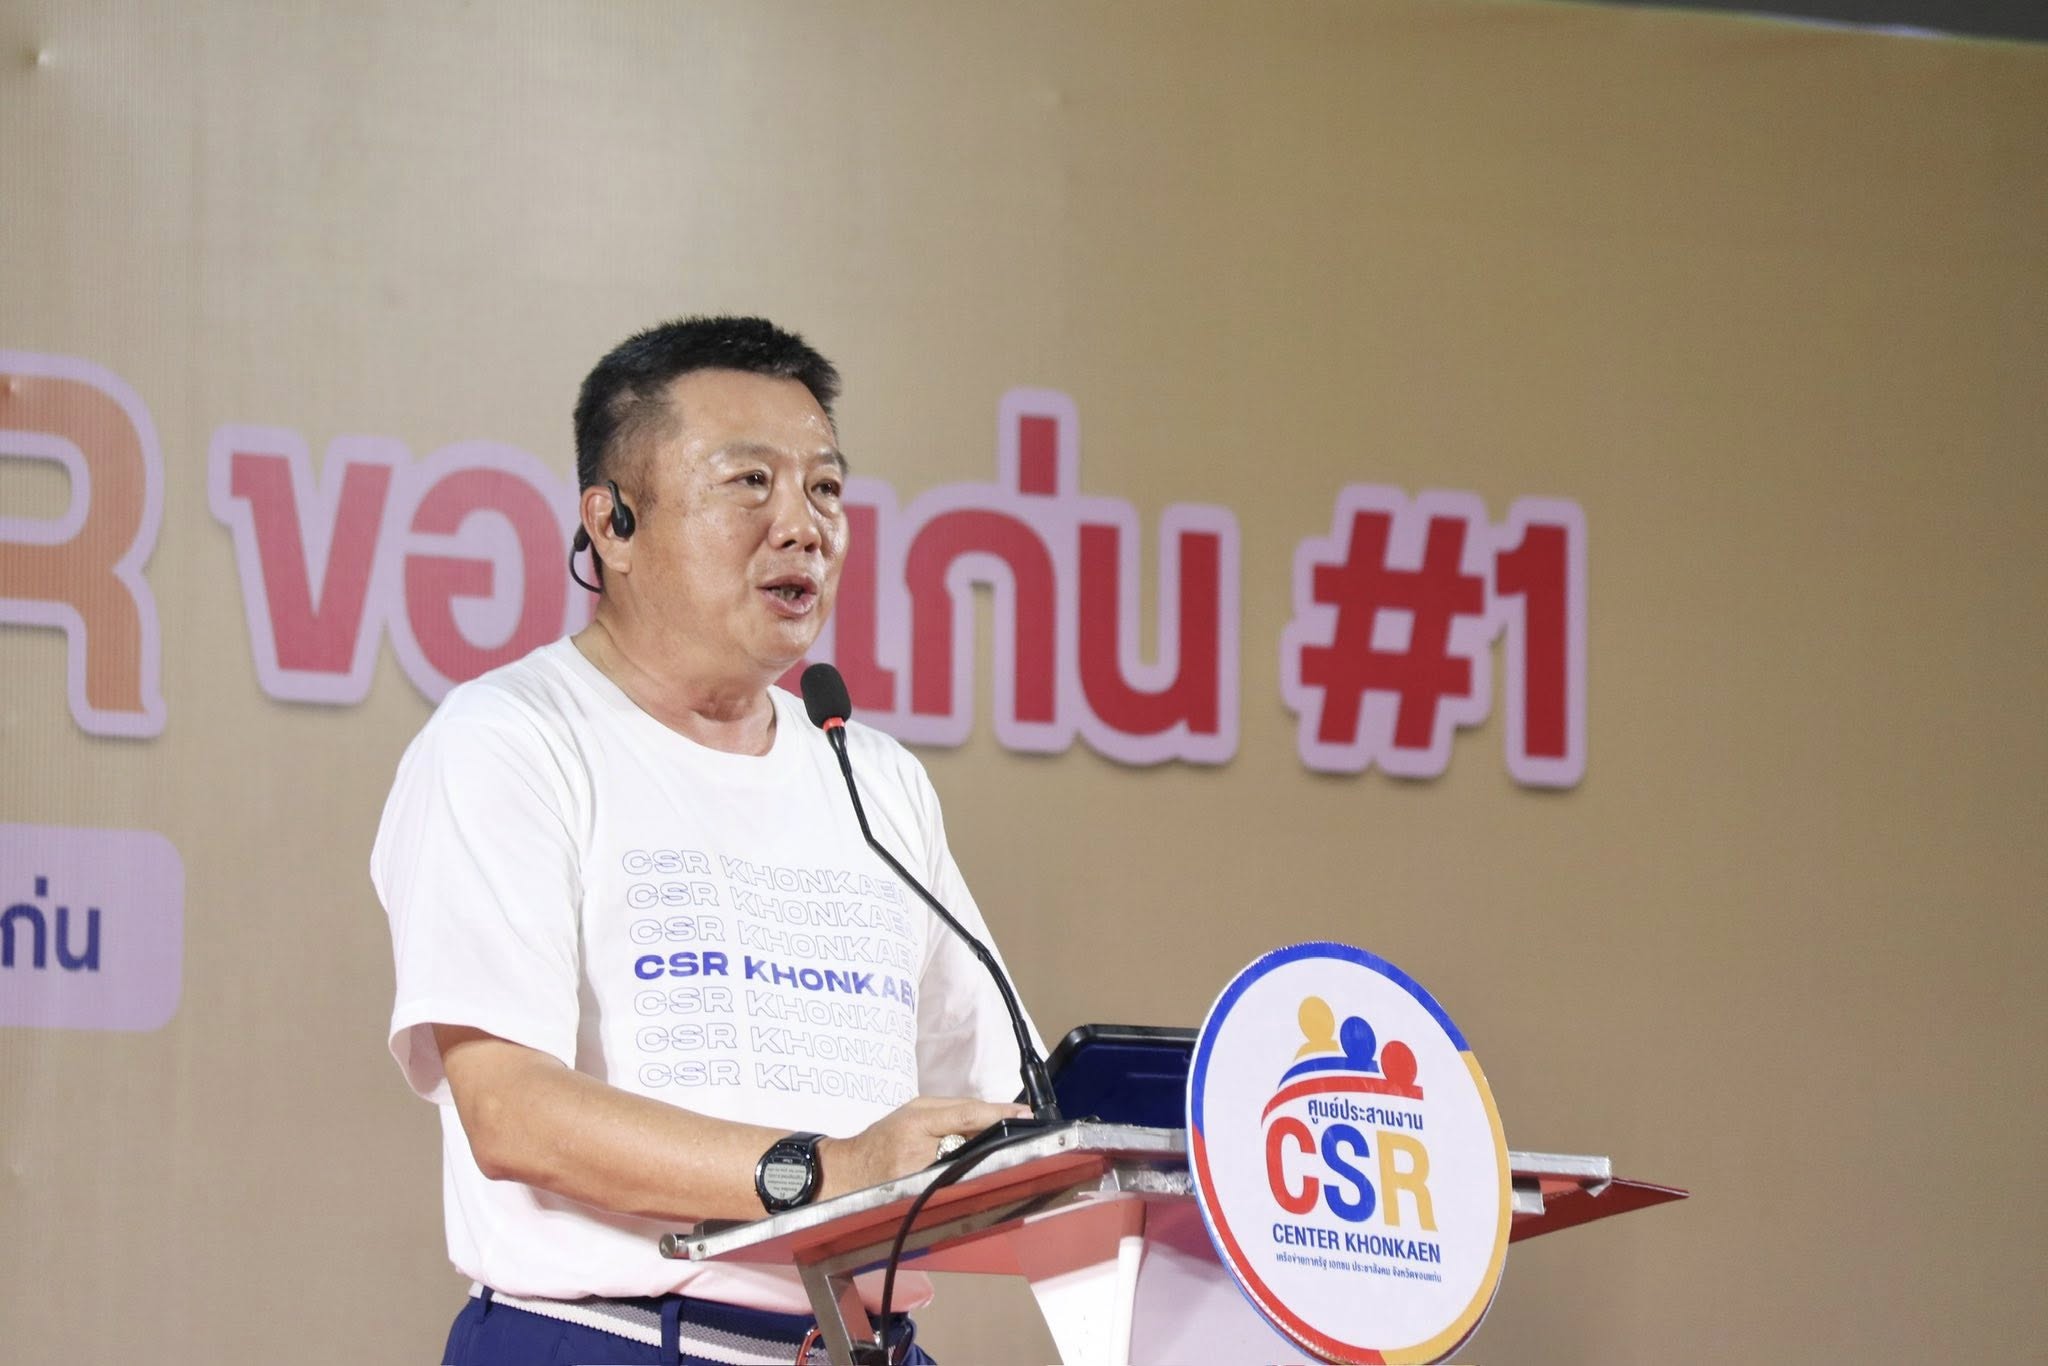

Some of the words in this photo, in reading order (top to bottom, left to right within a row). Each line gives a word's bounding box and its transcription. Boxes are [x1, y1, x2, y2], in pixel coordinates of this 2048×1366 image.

[1301, 509, 1568, 758] #1
[622, 850, 711, 875] CSR
[626, 882, 720, 909] CSR
[629, 915, 725, 945] CSR
[634, 952, 729, 980] CSR
[634, 986, 733, 1016] CSR
[636, 1023, 737, 1053] CSR
[638, 1059, 740, 1088] CSR
[1308, 1097, 1423, 1130] ศูนย์ประสานงาน
[1266, 1116, 1439, 1232] CSR
[1272, 1223, 1340, 1250] CENTER
[1344, 1232, 1442, 1264] KHONKAEN
